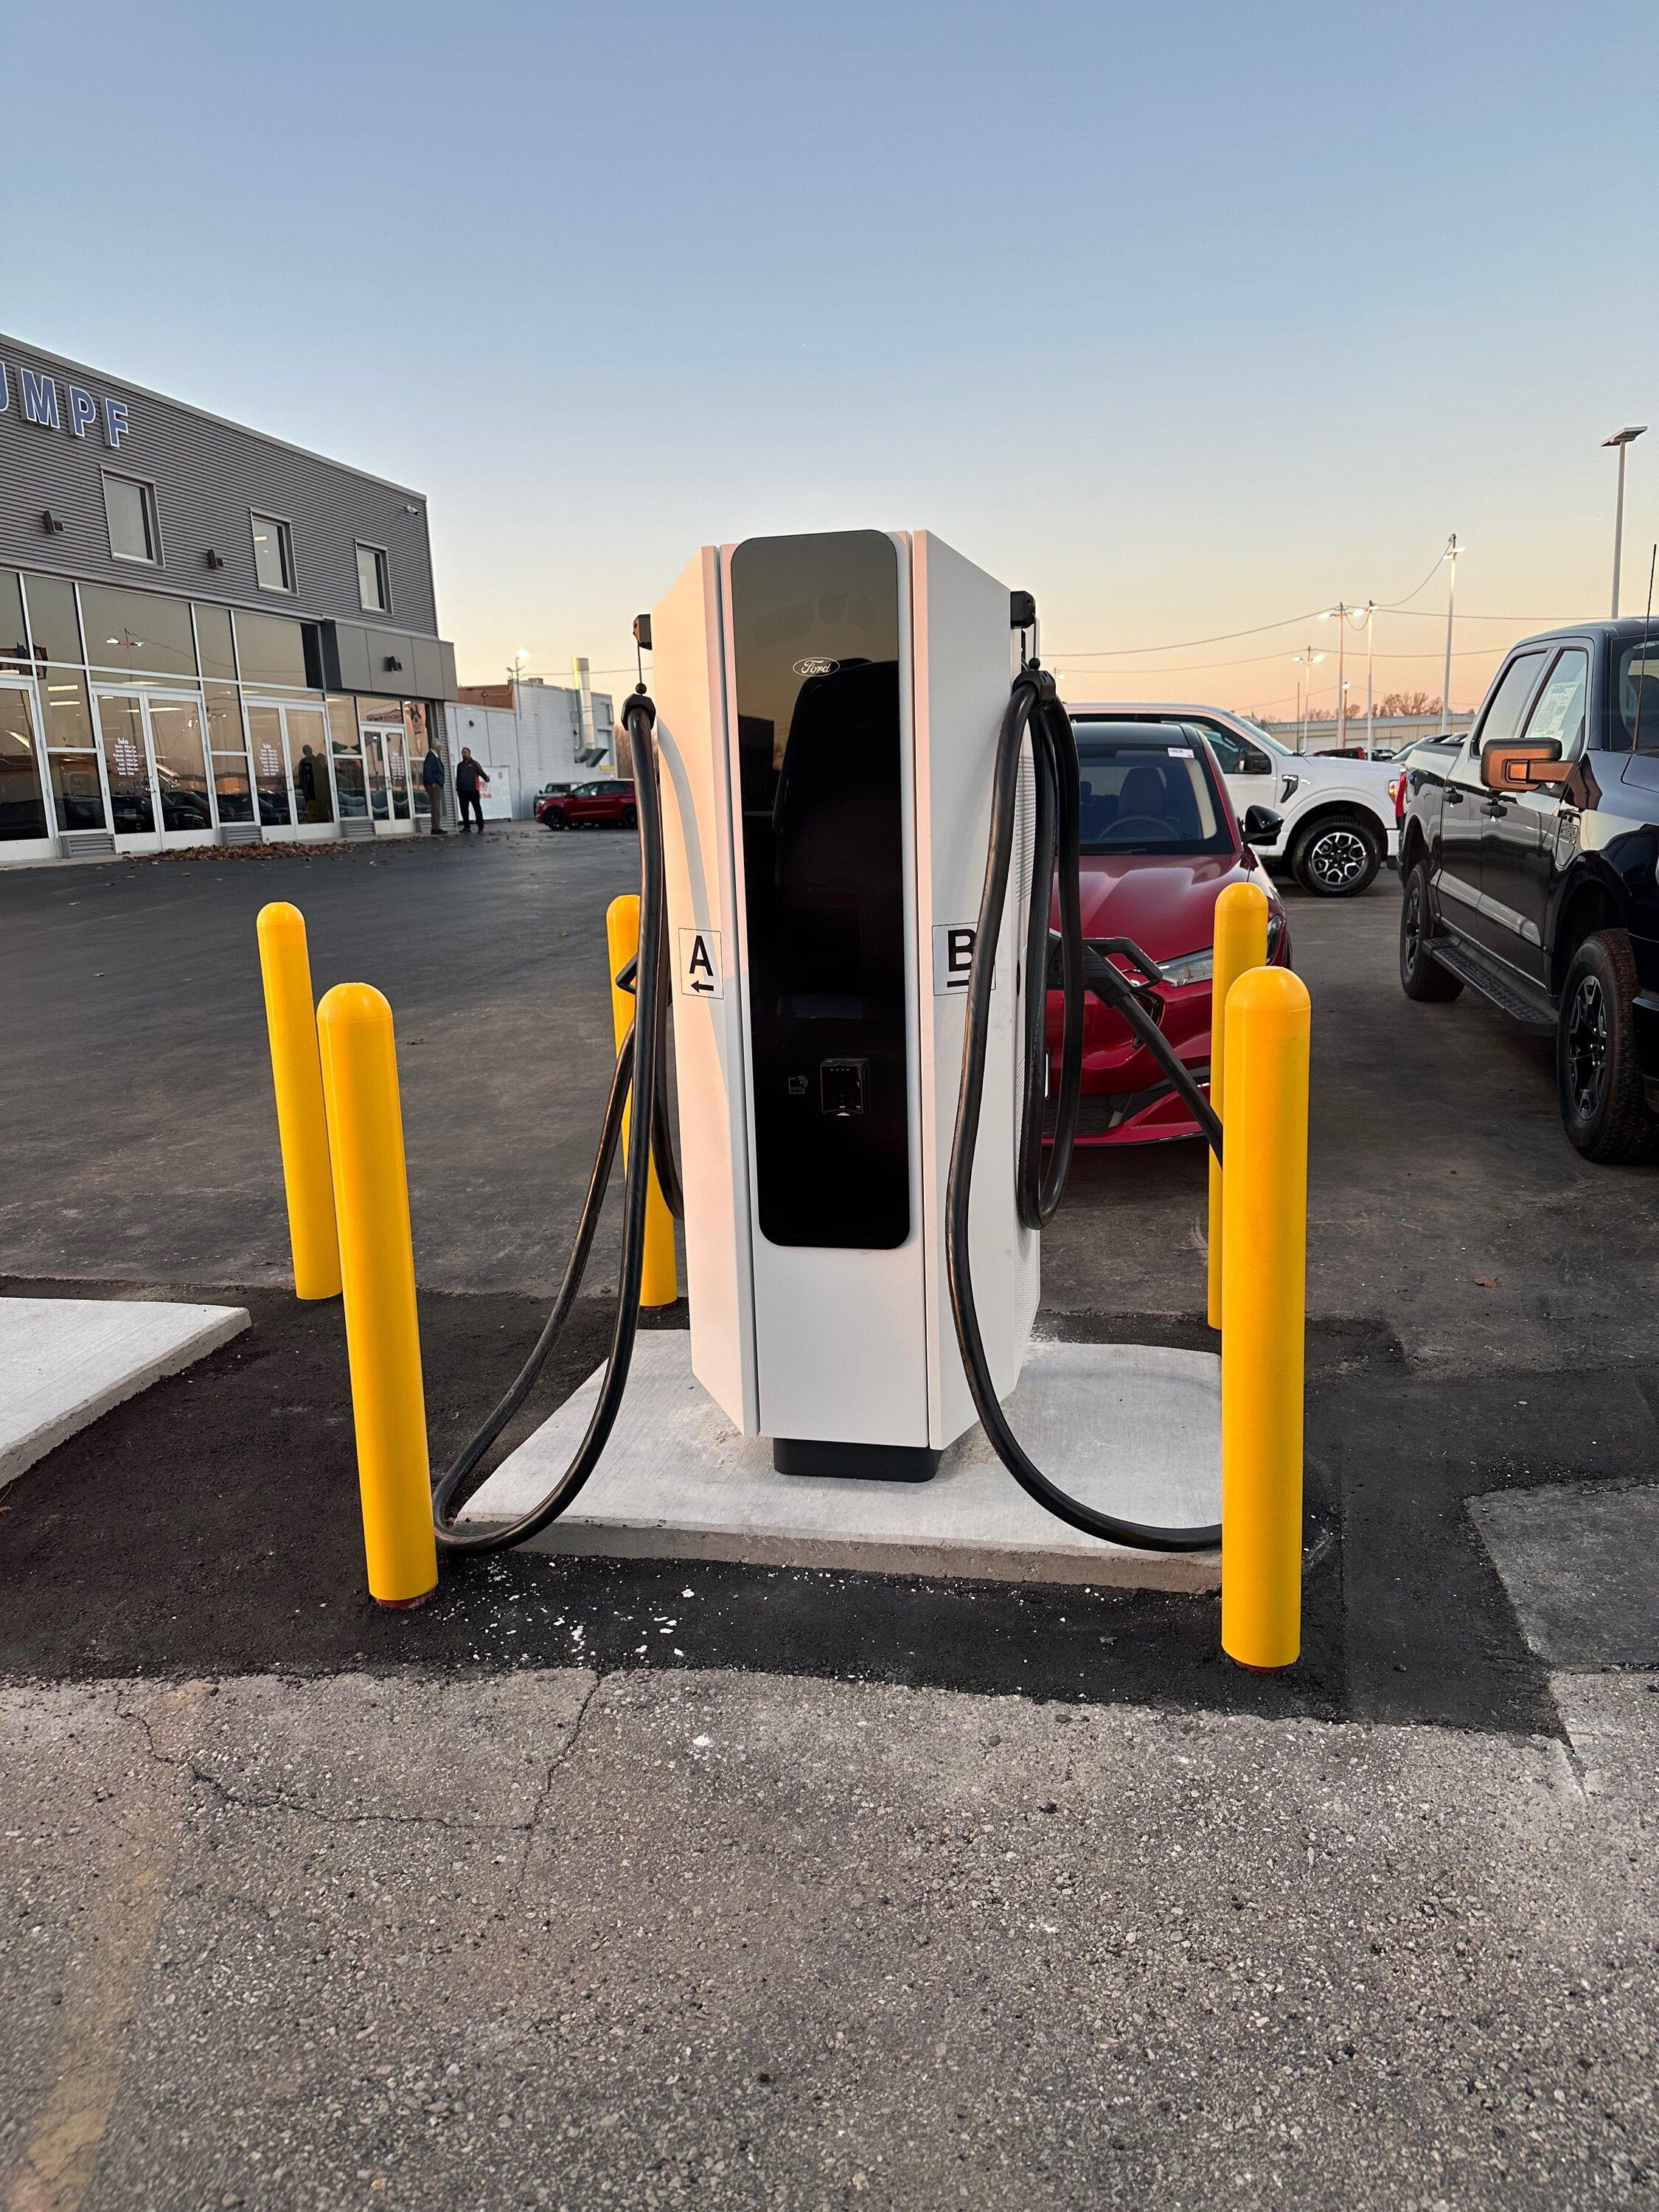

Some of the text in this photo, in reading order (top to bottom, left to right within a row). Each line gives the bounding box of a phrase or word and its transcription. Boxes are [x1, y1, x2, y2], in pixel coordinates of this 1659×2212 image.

[801, 659, 832, 674] Ford
[689, 935, 714, 977] A
[947, 928, 976, 973] B
